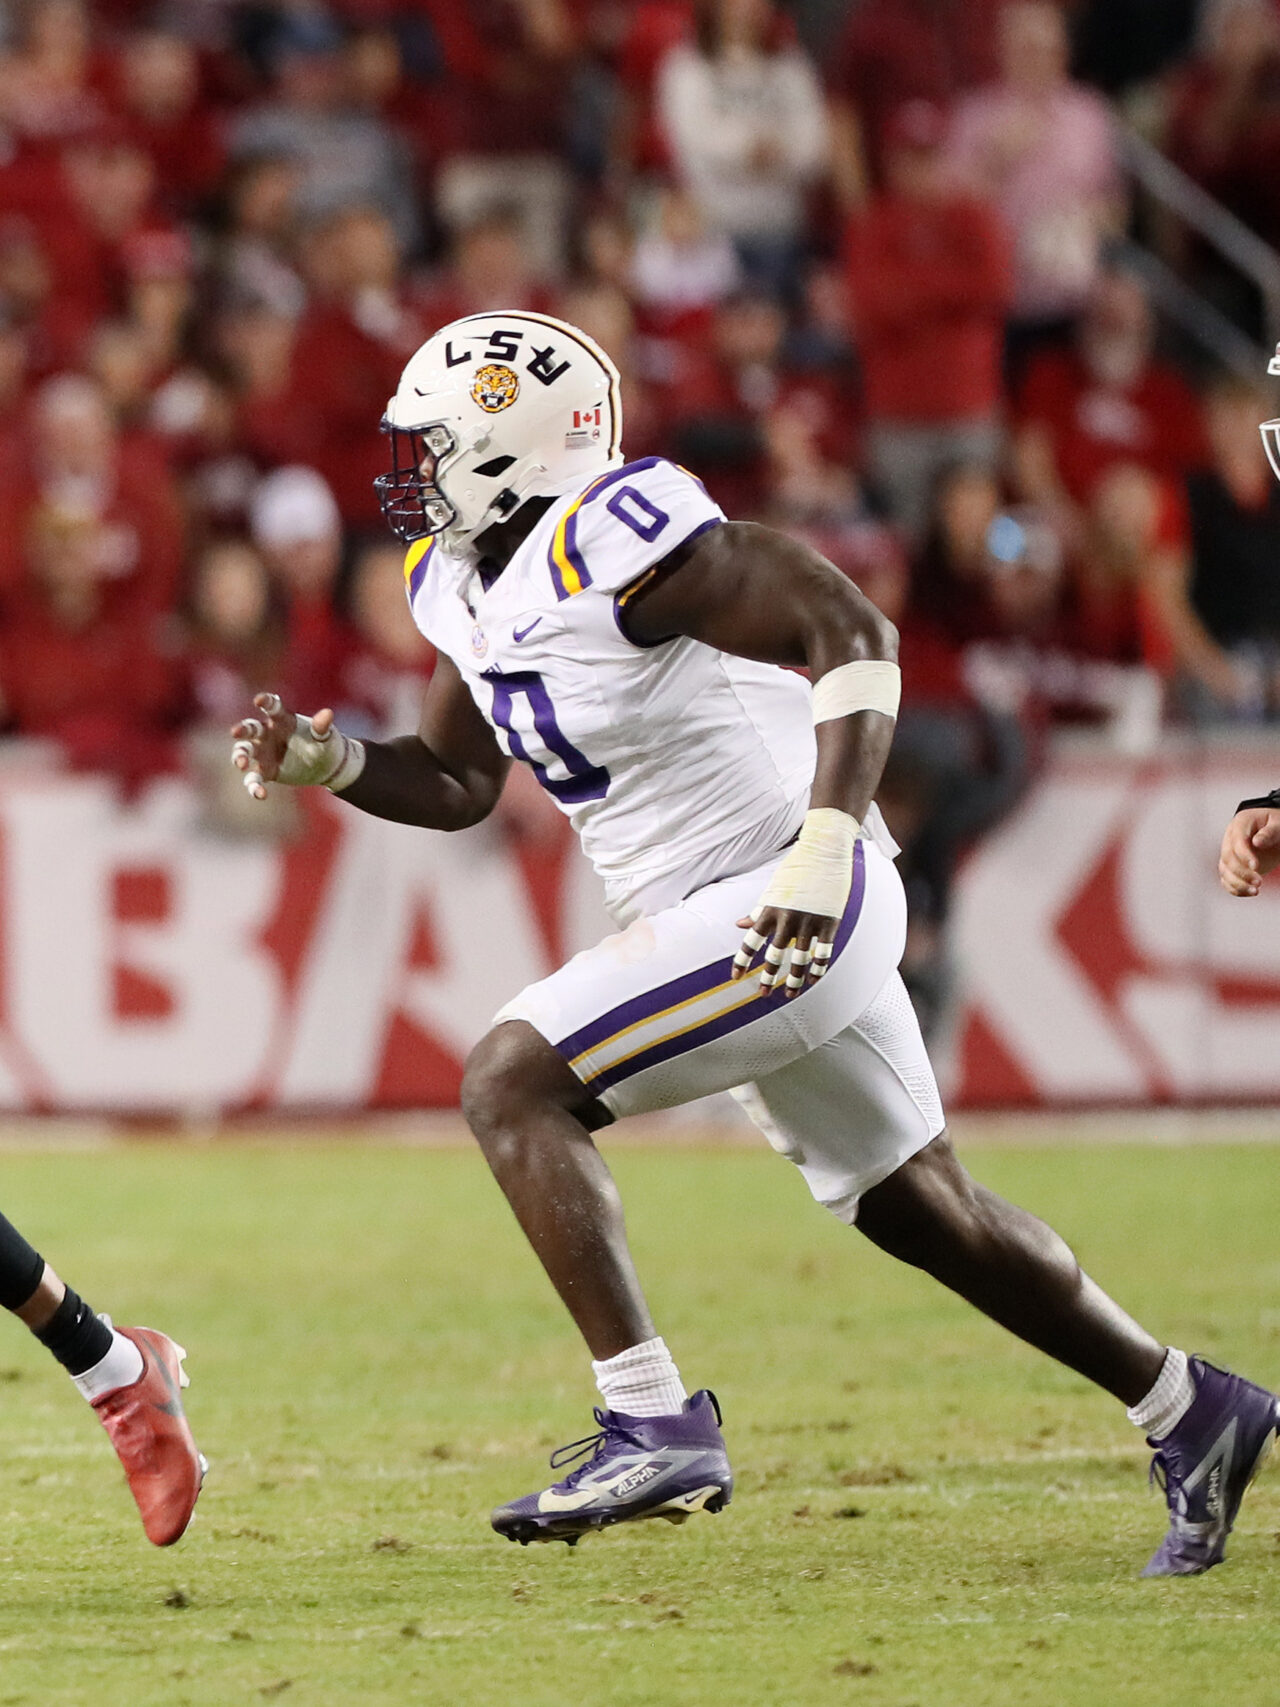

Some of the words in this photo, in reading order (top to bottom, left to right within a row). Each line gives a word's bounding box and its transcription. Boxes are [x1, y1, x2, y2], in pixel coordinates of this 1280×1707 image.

[446, 330, 572, 387] LSU
[607, 485, 669, 543] 0
[484, 670, 612, 804] 0
[617, 1466, 660, 1497] ALPHA
